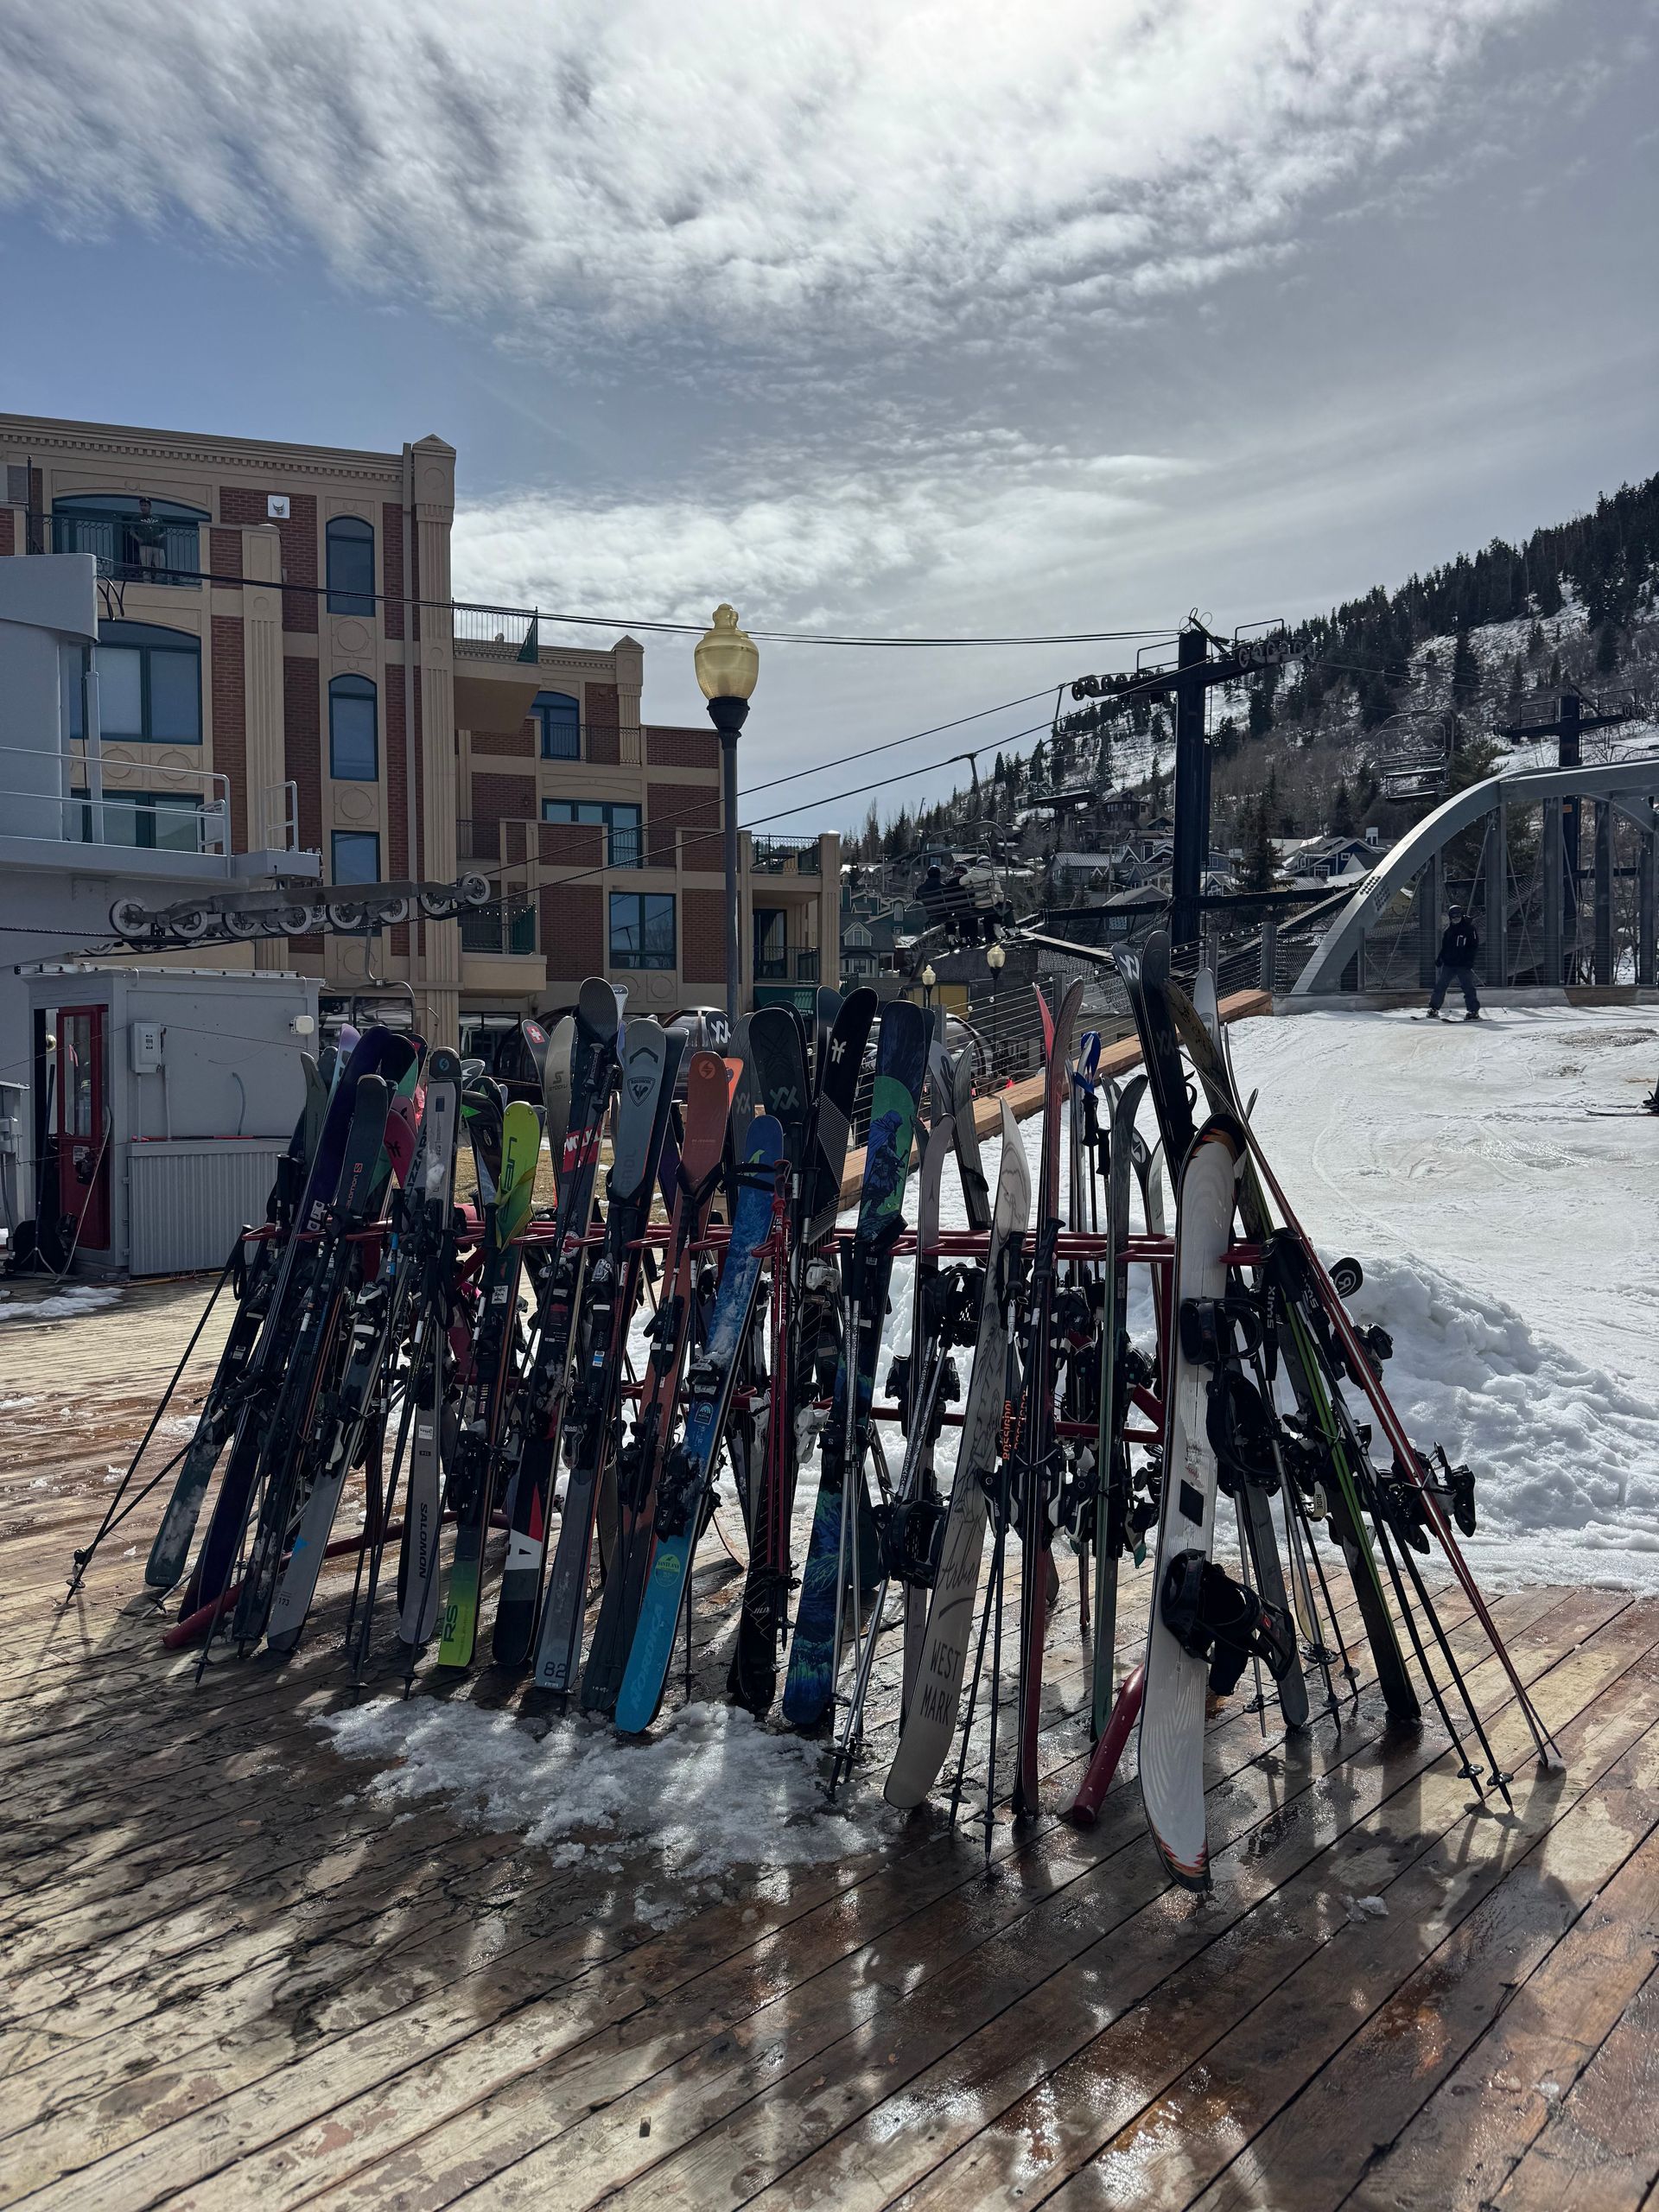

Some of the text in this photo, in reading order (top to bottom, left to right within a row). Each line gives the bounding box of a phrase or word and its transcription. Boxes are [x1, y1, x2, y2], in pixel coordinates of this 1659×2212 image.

[1267, 1286, 1276, 1329] SWIX
[418, 1502, 429, 1580] SALOMON
[442, 1605, 458, 1643] RS
[543, 1661, 567, 1680] 82
[930, 1638, 962, 1682] WEST
[919, 1683, 953, 1726] MARK
